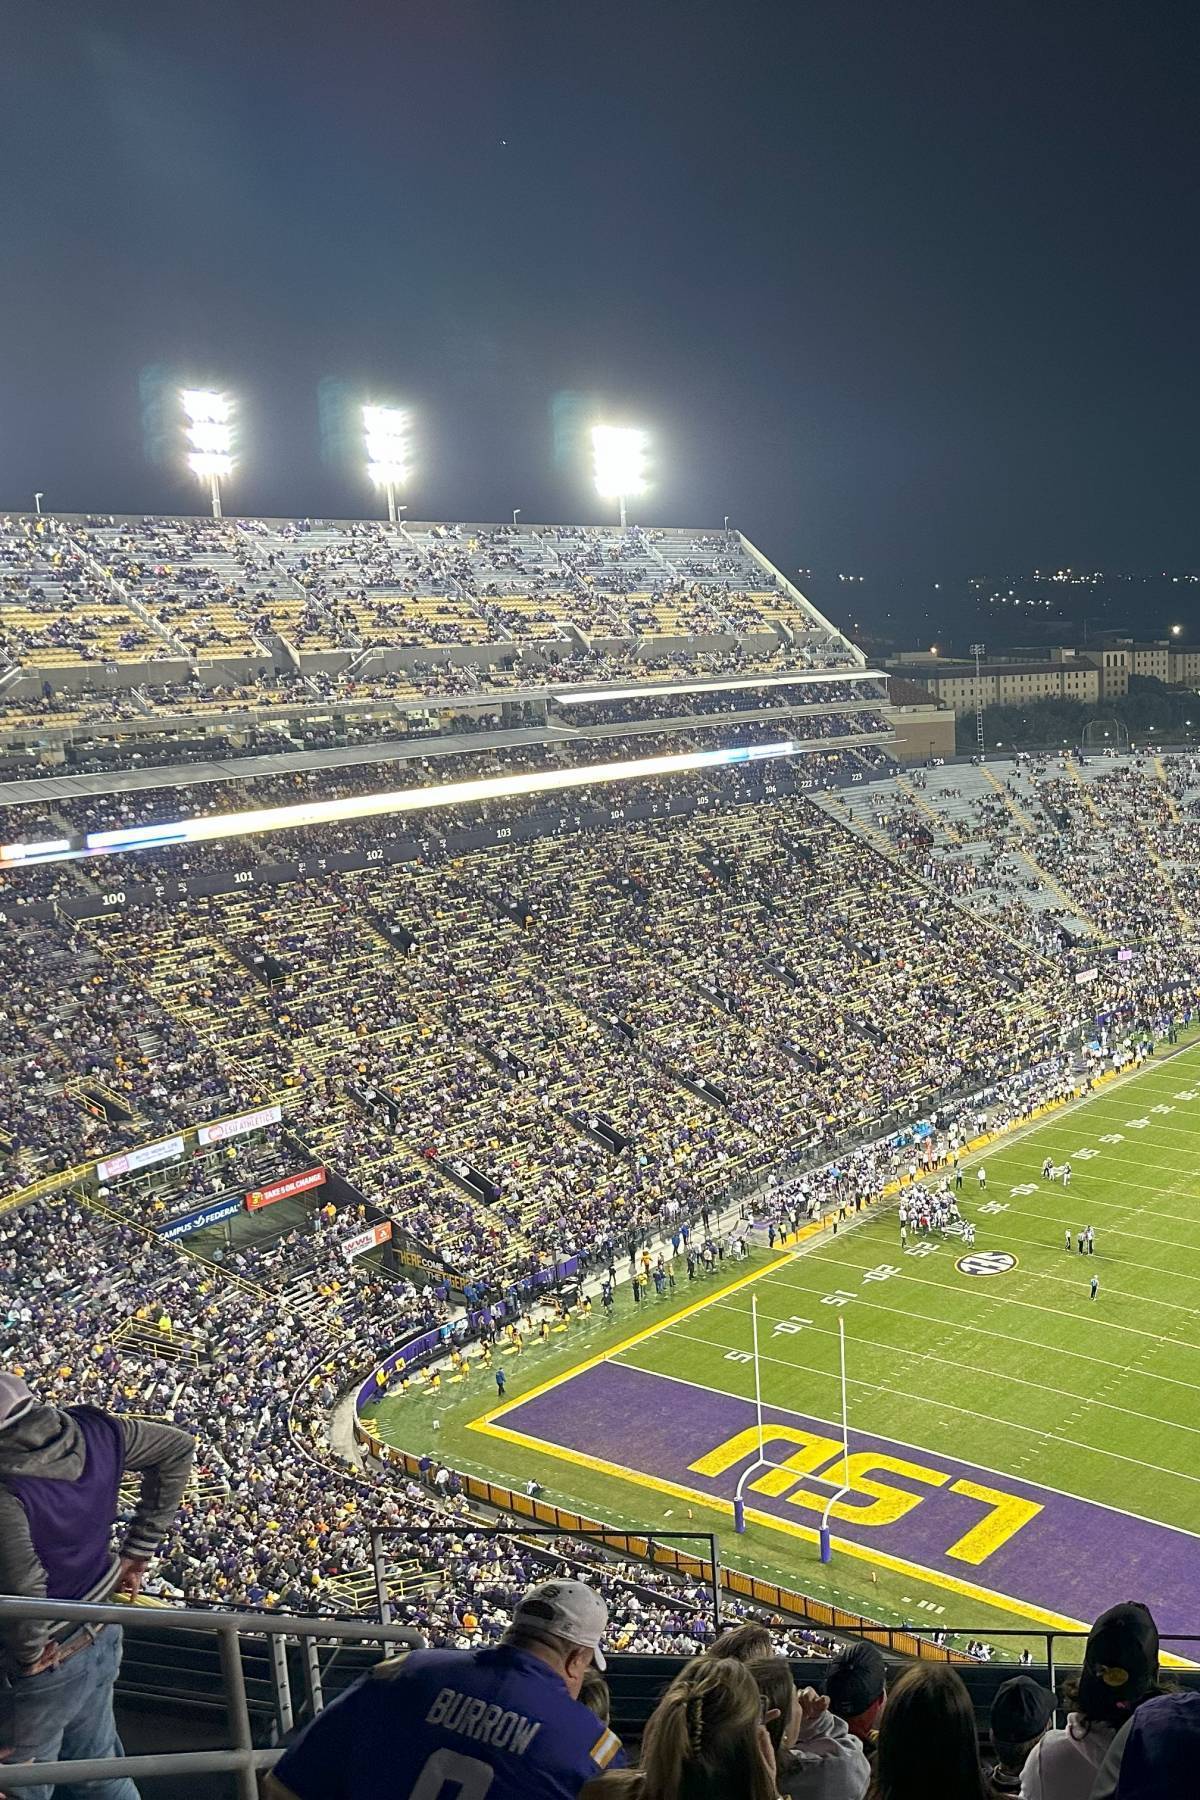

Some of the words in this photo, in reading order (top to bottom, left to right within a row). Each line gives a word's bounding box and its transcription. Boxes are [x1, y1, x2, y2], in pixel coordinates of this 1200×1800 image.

[800, 780, 813, 788] 222
[851, 773, 863, 781] 223
[765, 785, 777, 794] 106
[696, 796, 710, 806] 105
[610, 809, 625, 819] 104
[496, 827, 512, 839] 103
[366, 849, 384, 862] 102
[233, 871, 254, 884] 101
[102, 892, 126, 906] 100
[239, 1109, 275, 1133] ATHLETICS
[264, 1187, 281, 1200] TAKE
[285, 1182, 297, 1193] OIL
[296, 1172, 321, 1188] CHANGE
[158, 1222, 193, 1242] CAMPUS
[205, 1205, 239, 1223] FEDERAL
[343, 1234, 373, 1251] WWL
[903, 1241, 941, 1258] 25
[400, 1251, 422, 1269] HERE
[421, 1256, 445, 1271] COME
[958, 1251, 1016, 1276] SEC
[425, 1270, 443, 1282] THE
[441, 1271, 470, 1291] TGER
[862, 1263, 902, 1282] 20
[819, 1288, 858, 1308] 15
[773, 1315, 814, 1335] 10
[723, 1350, 755, 1365] 5
[687, 1424, 1046, 1566] LSU
[424, 1687, 542, 1756] BURROW
